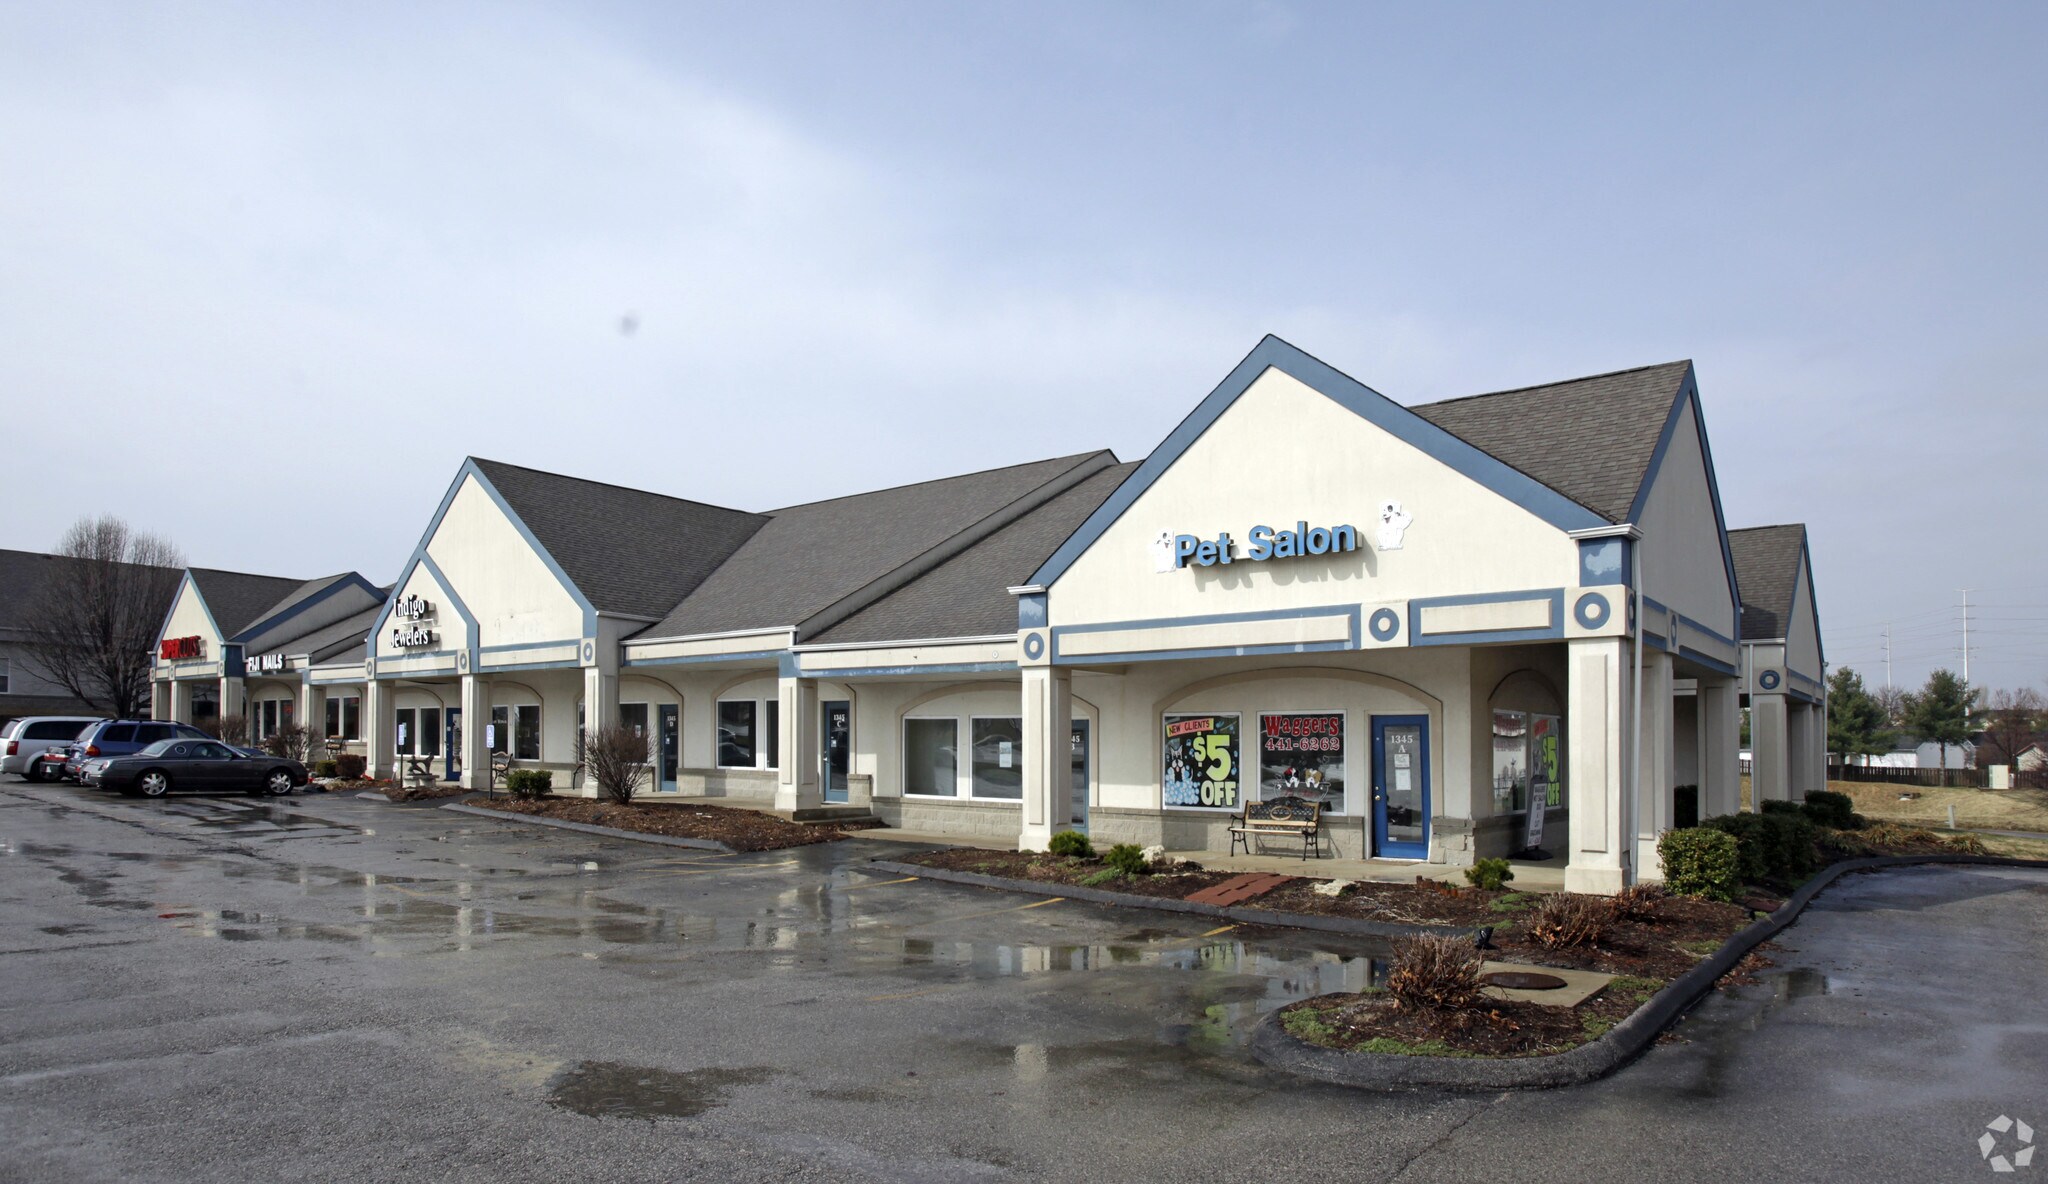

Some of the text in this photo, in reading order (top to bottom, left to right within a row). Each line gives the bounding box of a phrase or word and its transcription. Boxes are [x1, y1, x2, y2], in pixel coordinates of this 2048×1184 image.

[1174, 520, 1356, 569] Pet Salon
[393, 594, 427, 619] Indigo
[390, 626, 430, 648] Jewelers
[248, 653, 283, 671] FIJI NAILS
[833, 714, 846, 722] 1345
[836, 720, 842, 728] C
[1168, 719, 1210, 734] NEW CLIENTS
[1264, 715, 1339, 737] Waggers
[1264, 737, 1340, 751] 441-6262
[1391, 734, 1413, 744] 1345
[1398, 744, 1406, 753] A
[1192, 731, 1232, 782] $5
[1200, 780, 1237, 806] OFF
[1547, 782, 1560, 807] OFF
